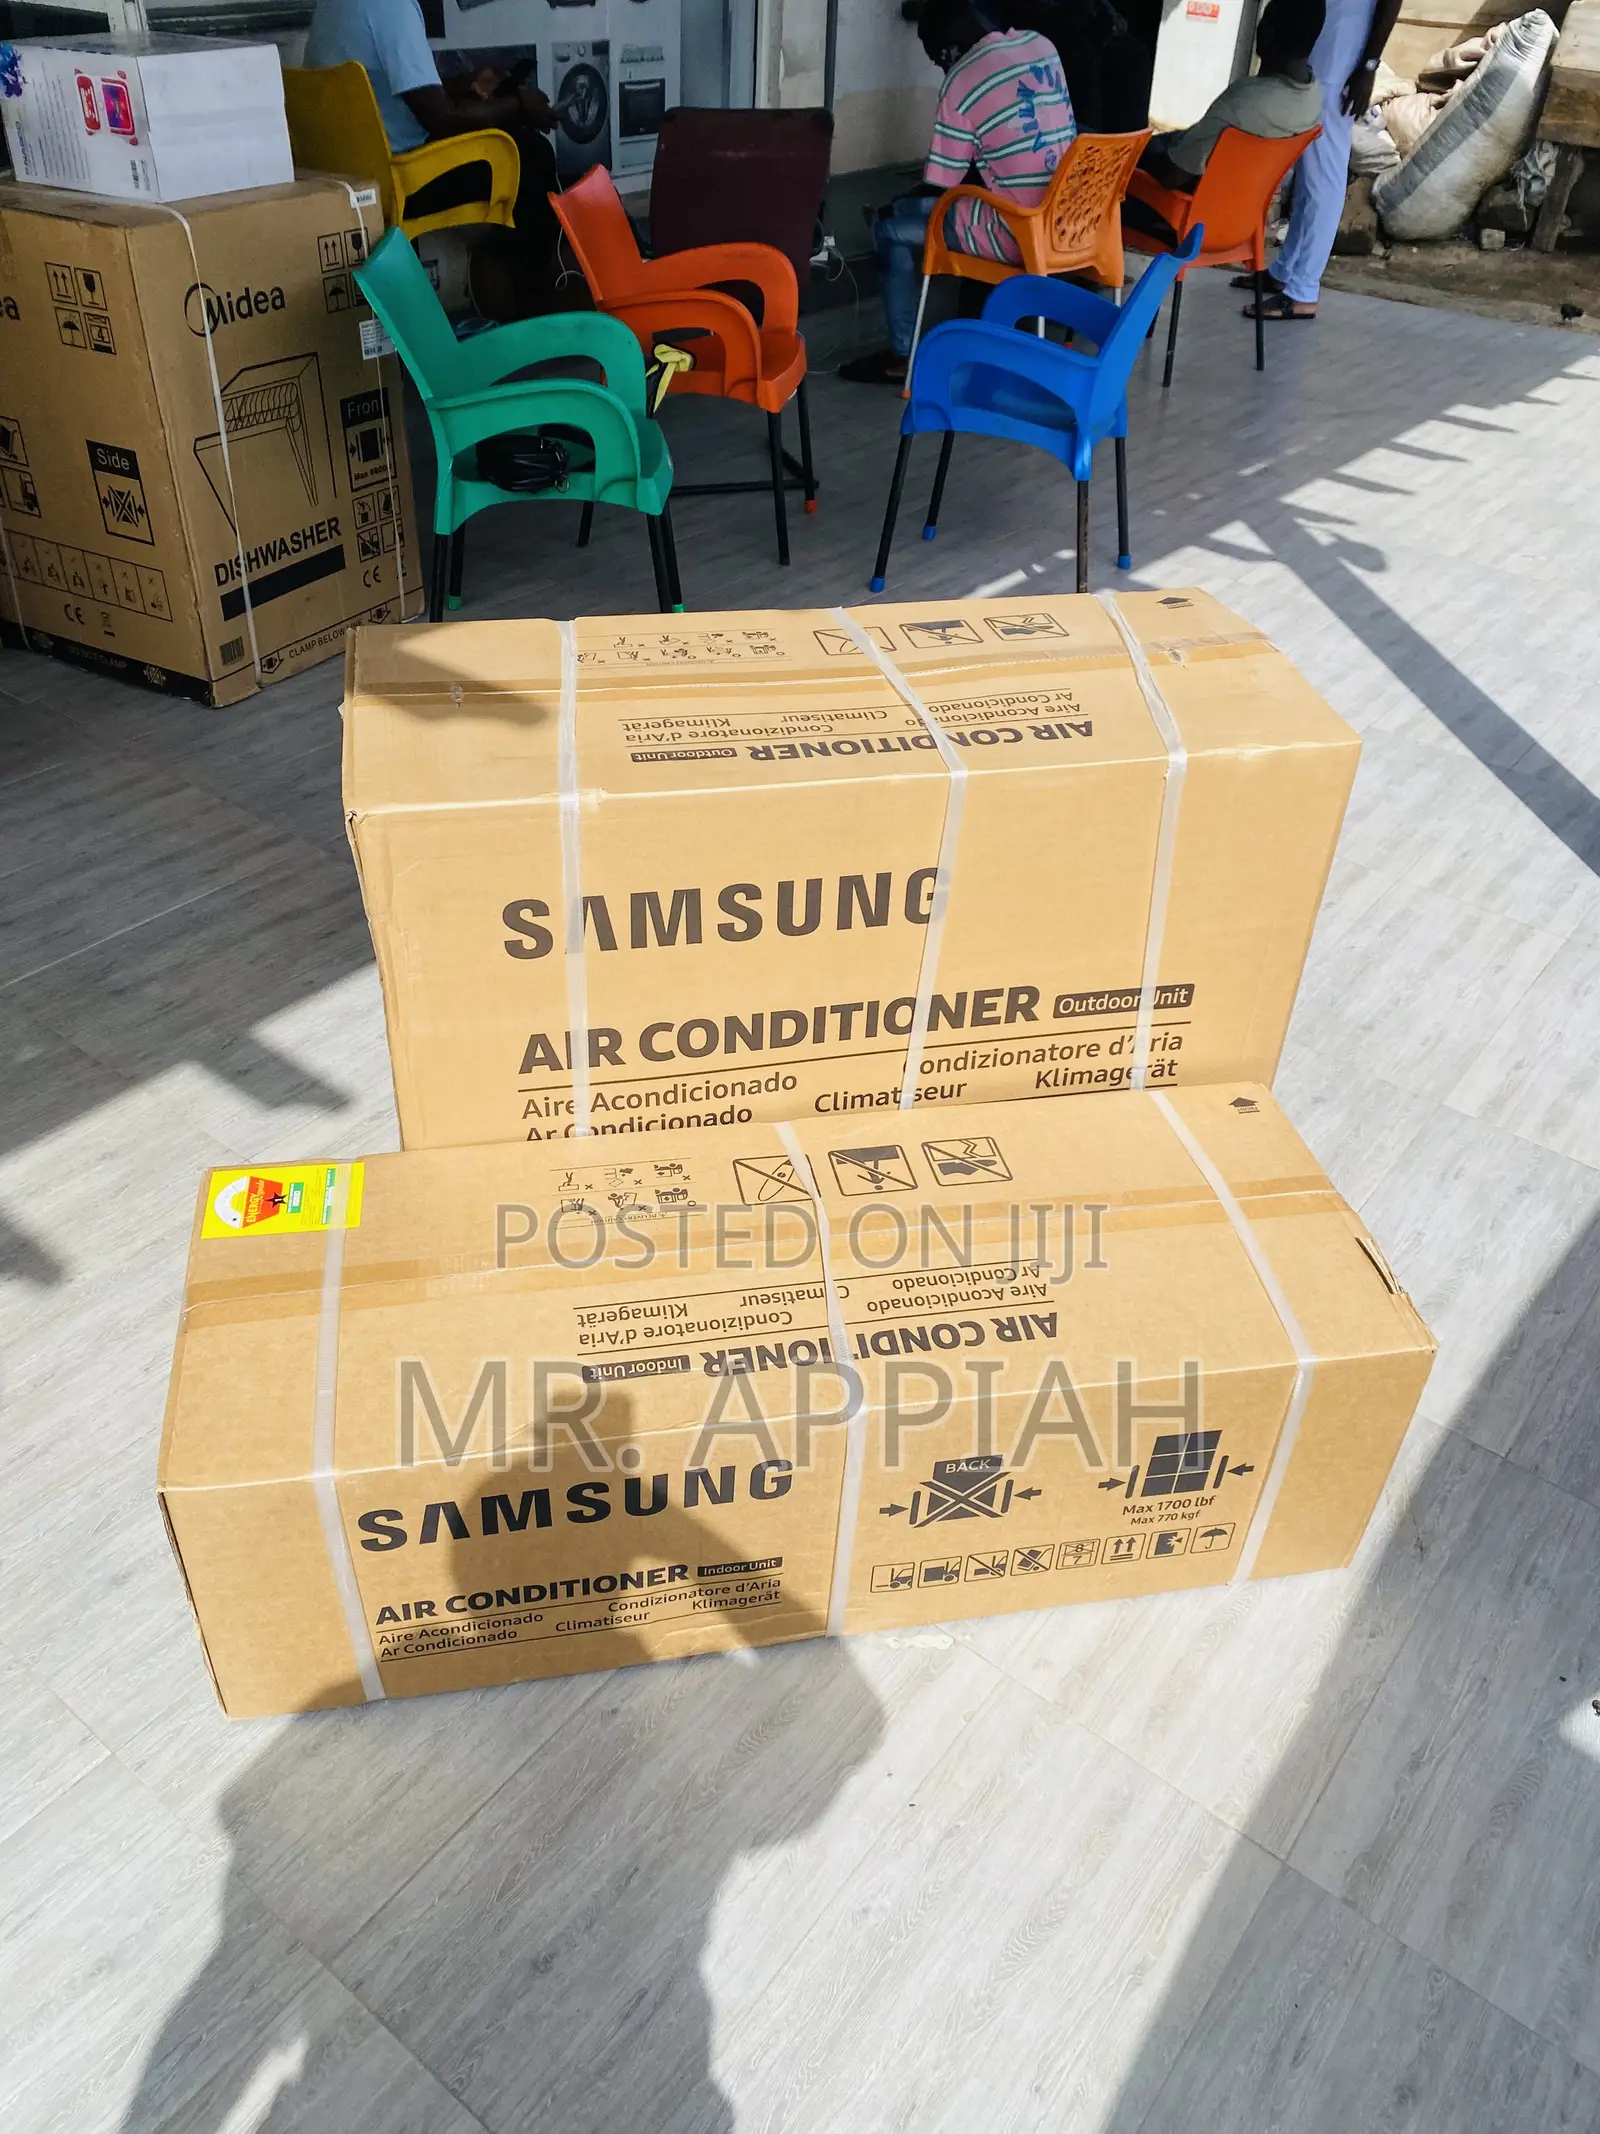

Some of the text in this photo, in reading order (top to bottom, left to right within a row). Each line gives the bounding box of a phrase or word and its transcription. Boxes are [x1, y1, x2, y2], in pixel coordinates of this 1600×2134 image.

[202, 285, 286, 331] Midea
[347, 399, 380, 420] Fron
[96, 447, 131, 471] Side
[213, 516, 342, 587] DISHWASHER
[288, 640, 317, 659] CLAMP
[317, 626, 346, 647] BELOW
[621, 691, 1074, 735] Ar Condicionado Climatiseur Klimagerät
[904, 706, 1040, 730] Acondiciondo
[1043, 703, 1082, 717] Aire
[632, 720, 1094, 763] AIR CONDITIONER Outdoor Unit
[688, 723, 834, 746] Condizionatore
[502, 867, 949, 960] SAMSUNG
[639, 985, 1040, 1062] CONDITIONER
[1059, 994, 1141, 1014] Outdoor
[522, 1032, 1184, 1120] Aire Acondicionado ondizionatore d’ria
[564, 1104, 753, 1139] ndicionado
[815, 1081, 968, 1114] Climatseur
[1035, 1058, 1179, 1089] Klimageät
[245, 1191, 261, 1223] ENERGY
[576, 1263, 1042, 1330] Ar Condicionado Cmatiseur Klimagerät
[866, 1286, 1006, 1315] Acondicionado
[1009, 1282, 1048, 1300] Aire
[642, 1310, 793, 1341] Condizionatore
[991, 1311, 1059, 1343] AIR
[589, 1364, 626, 1381] Unit
[629, 1356, 685, 1375] Indoor
[945, 1458, 991, 1474] BACK
[358, 1459, 793, 1552] SAMSUNG
[1122, 1502, 1154, 1516] Max
[1157, 1497, 1192, 1512] 1700
[1130, 1509, 1201, 1526] Max 770 kgf
[376, 1558, 777, 1625] AIR CONDITIONER Indoor Unit
[378, 1628, 415, 1645] Aire
[418, 1611, 544, 1639] Acondicionado
[607, 1586, 731, 1612] Condizionatore
[380, 1590, 781, 1658] Ar Condicionado Climatiseur Klimagerät
